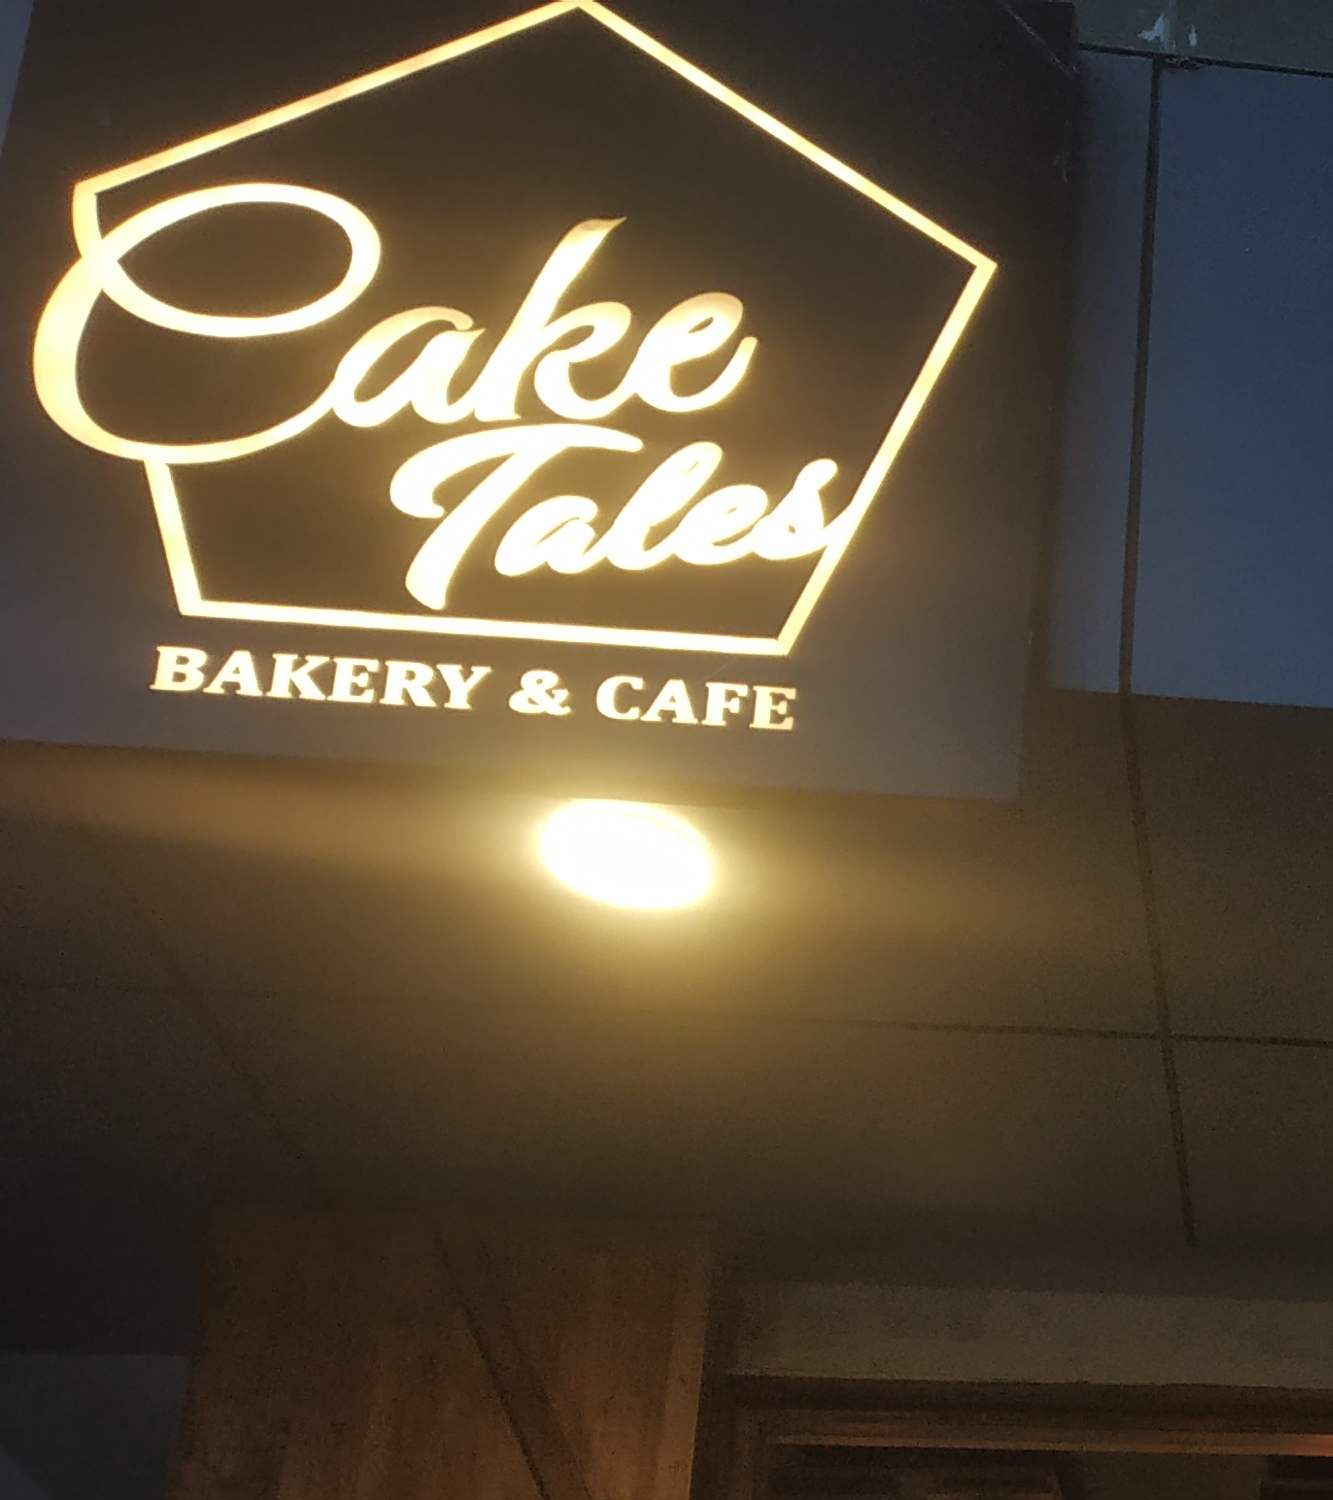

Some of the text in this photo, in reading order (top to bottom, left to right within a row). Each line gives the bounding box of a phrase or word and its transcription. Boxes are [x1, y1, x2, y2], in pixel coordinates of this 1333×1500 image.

[33, 182, 758, 464] Cake
[389, 422, 845, 611] Tales
[150, 645, 798, 731] BAKERY & CAFE
